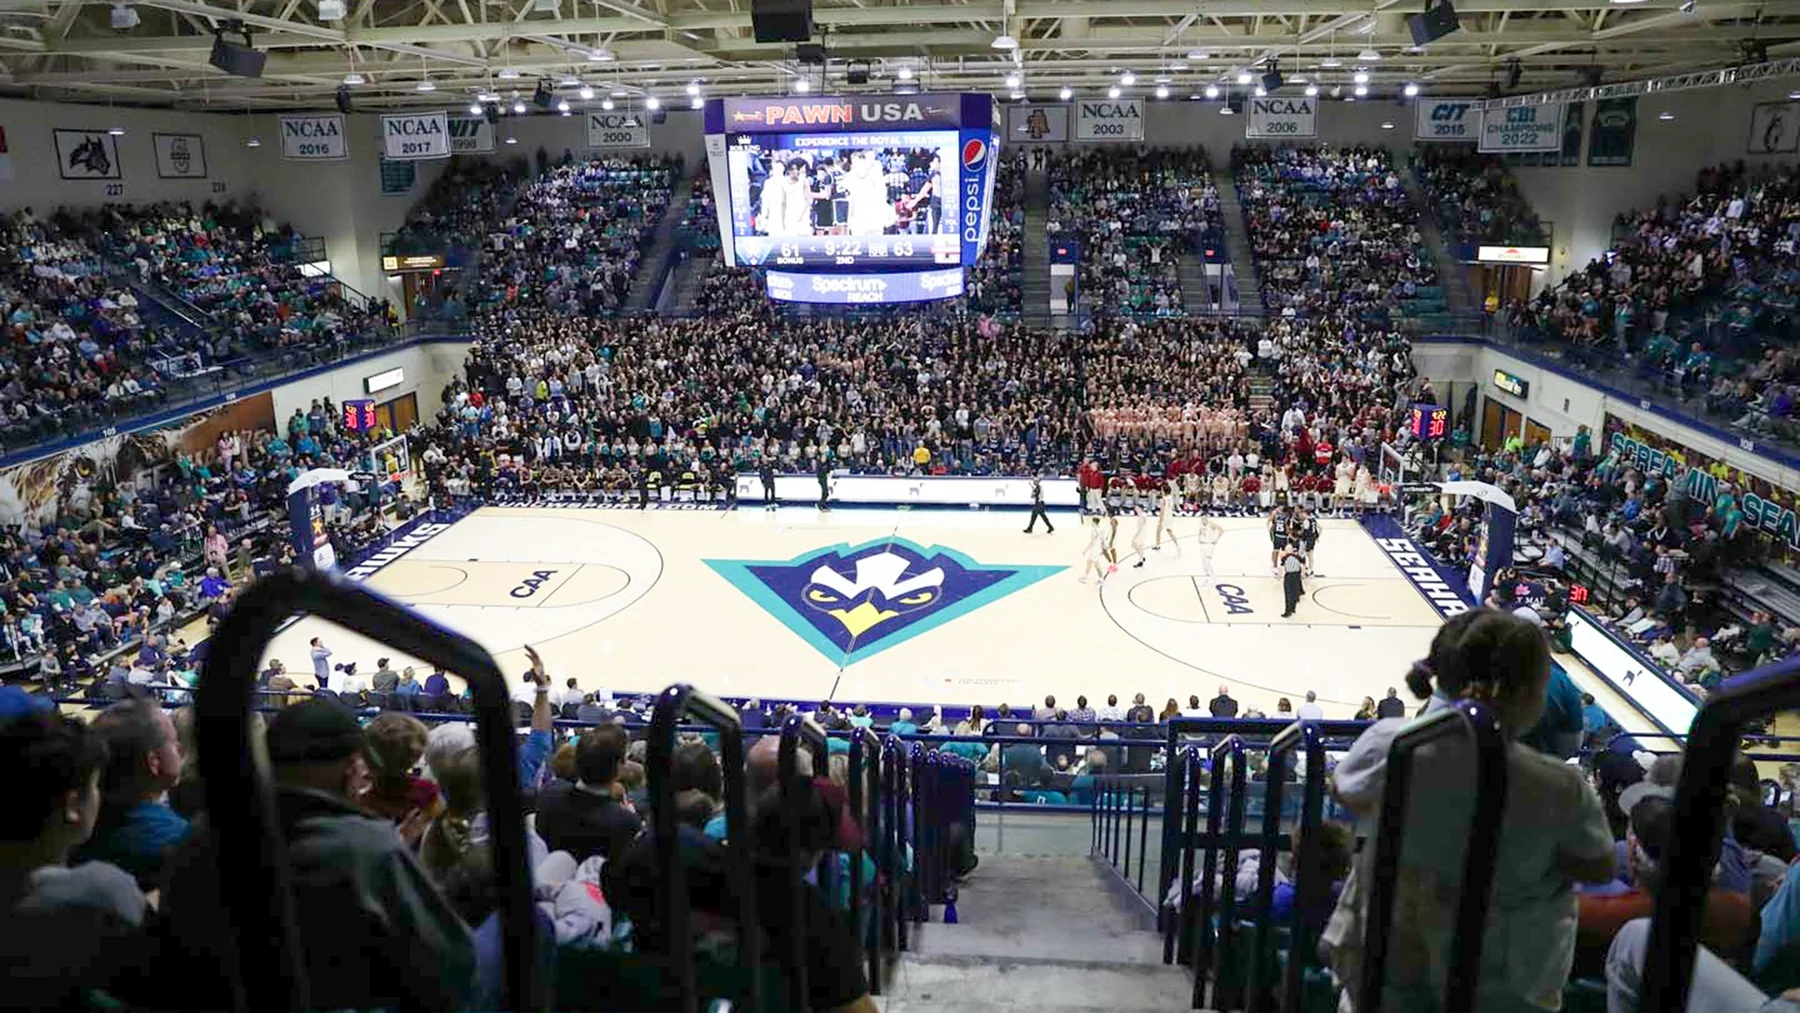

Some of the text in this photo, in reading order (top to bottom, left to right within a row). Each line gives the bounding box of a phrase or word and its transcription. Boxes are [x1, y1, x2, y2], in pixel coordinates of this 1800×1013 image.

[766, 103, 923, 125] PAWN USA
[1081, 103, 1140, 119] NCAA
[1253, 100, 1313, 115] NCAA
[1431, 103, 1471, 121] CIT
[285, 120, 338, 137] NCAA
[388, 117, 441, 136] NCAA
[591, 115, 644, 130] NCAA
[1092, 124, 1125, 135] 2003
[1266, 122, 1297, 133] 2006
[1487, 123, 1555, 134] CHAMPIONS
[603, 131, 633, 143] 2000
[1501, 134, 1539, 146] 2022
[299, 143, 329, 155] 2016
[402, 142, 431, 154] 2017
[964, 176, 981, 243] pepsi
[781, 243, 799, 257] 61
[824, 239, 862, 256] 9:22
[893, 241, 914, 257] 63
[777, 256, 855, 265] BONUS 2ND
[811, 275, 882, 294] Spectrum
[847, 291, 884, 303] REACH
[1429, 420, 1445, 437] 30
[509, 568, 559, 599] CAA
[1215, 583, 1254, 614] CAA
